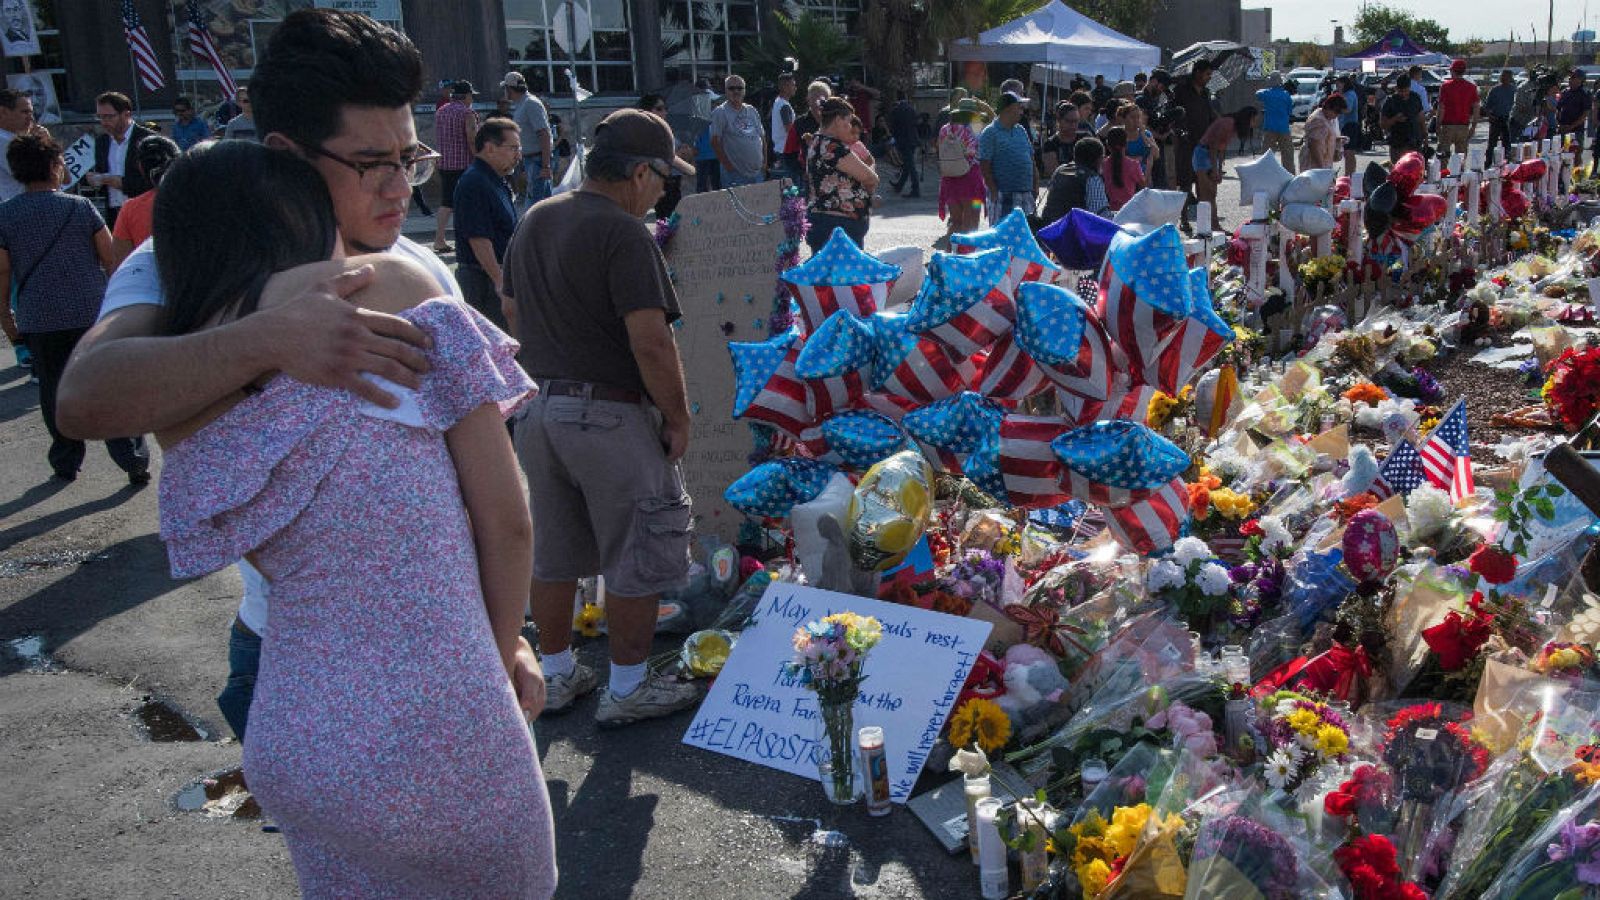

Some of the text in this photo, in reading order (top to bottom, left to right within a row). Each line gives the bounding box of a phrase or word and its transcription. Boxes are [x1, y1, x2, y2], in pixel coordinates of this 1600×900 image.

[766, 594, 966, 649] May ouls rest
[732, 683, 782, 714] Rivera
[876, 691, 904, 712] the
[889, 780, 914, 798] We
[905, 750, 929, 775] will
[917, 709, 945, 751] never
